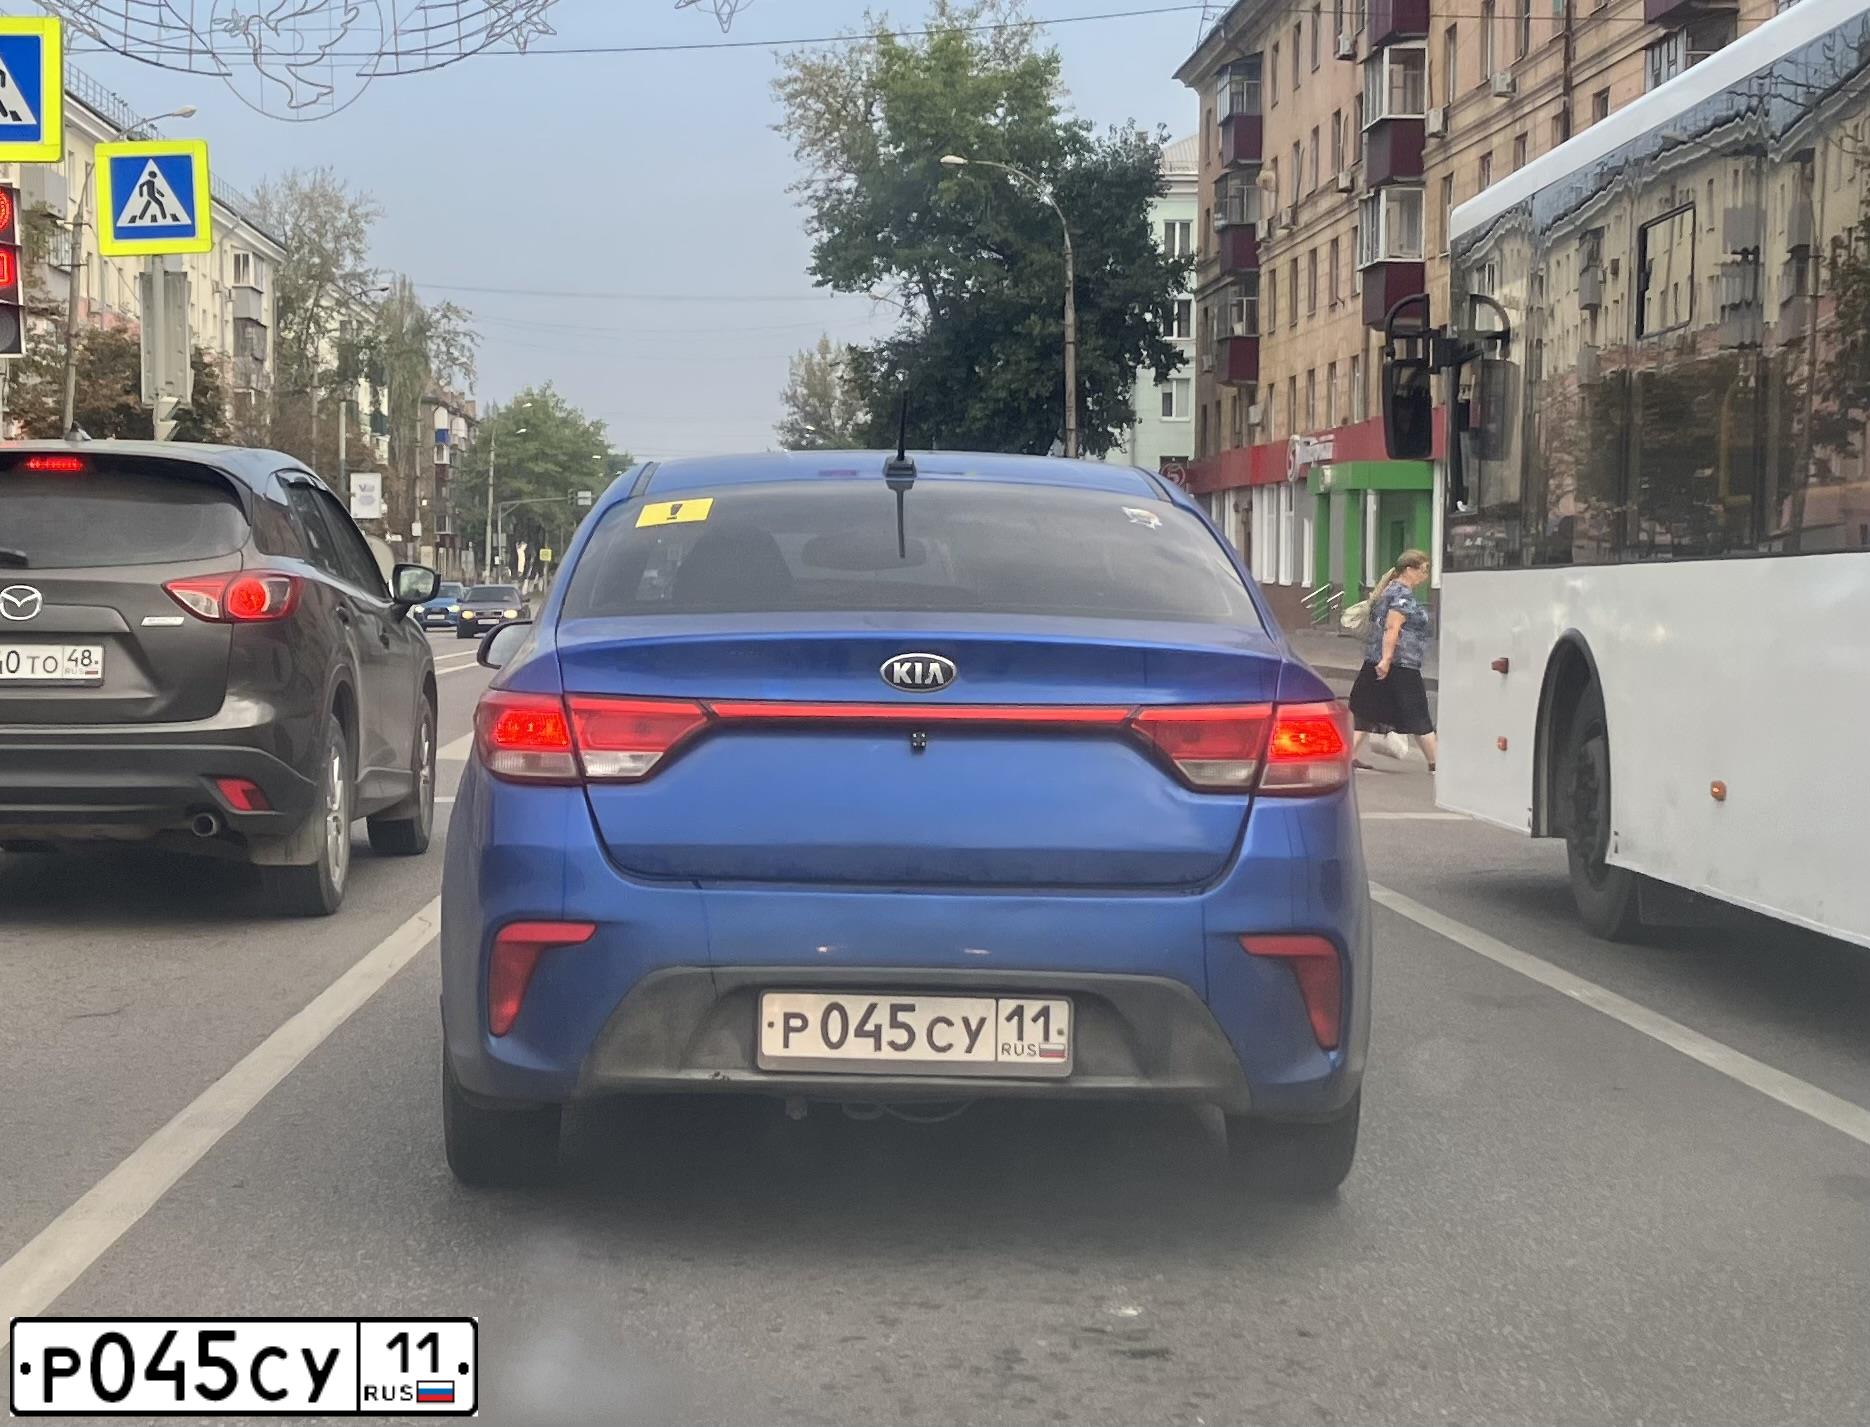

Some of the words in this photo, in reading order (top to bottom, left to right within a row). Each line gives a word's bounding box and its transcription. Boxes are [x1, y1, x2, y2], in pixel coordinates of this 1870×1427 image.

[67, 649, 92, 667] 48
[893, 662, 945, 685] KIA
[1004, 1004, 1051, 1042] 11
[1001, 1042, 1037, 1057] RUS
